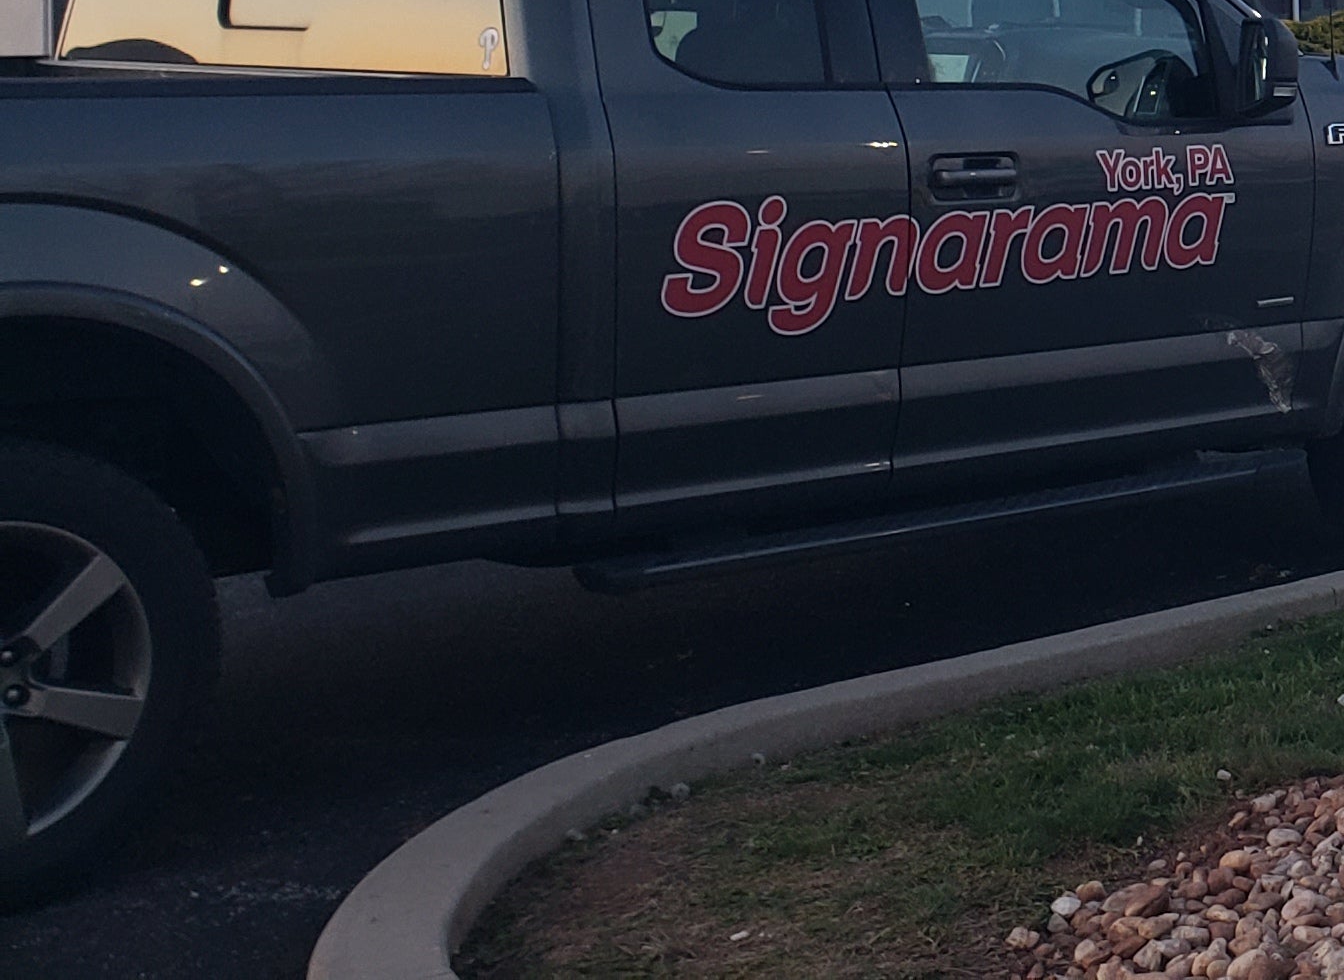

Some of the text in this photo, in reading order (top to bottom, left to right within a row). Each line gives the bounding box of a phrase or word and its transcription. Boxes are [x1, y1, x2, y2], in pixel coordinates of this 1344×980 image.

[1095, 144, 1234, 197] York, PA
[661, 192, 1229, 336] Signarama
